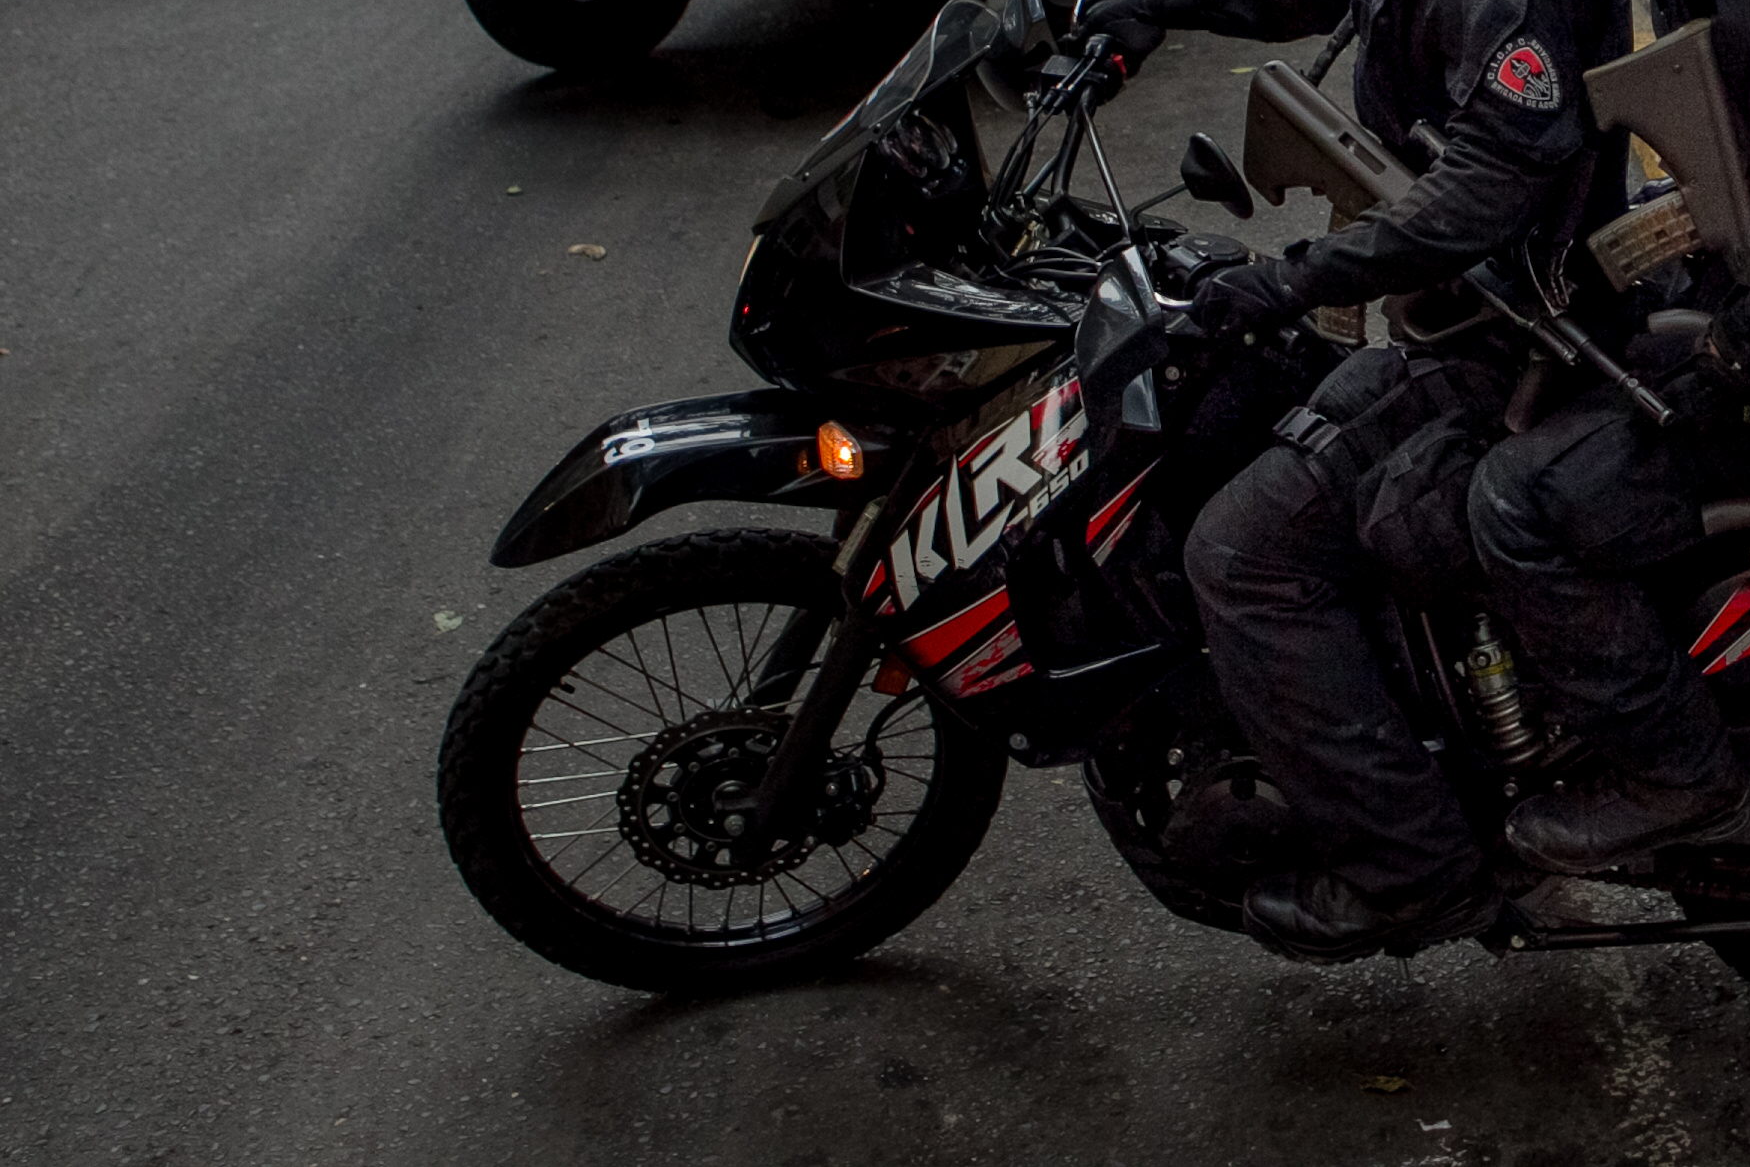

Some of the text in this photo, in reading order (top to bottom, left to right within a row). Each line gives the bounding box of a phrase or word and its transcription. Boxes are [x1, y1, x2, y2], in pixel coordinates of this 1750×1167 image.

[1490, 81, 1524, 105] BRIGADA
[890, 408, 1044, 612] KLR
[1029, 448, 1090, 520] 650
